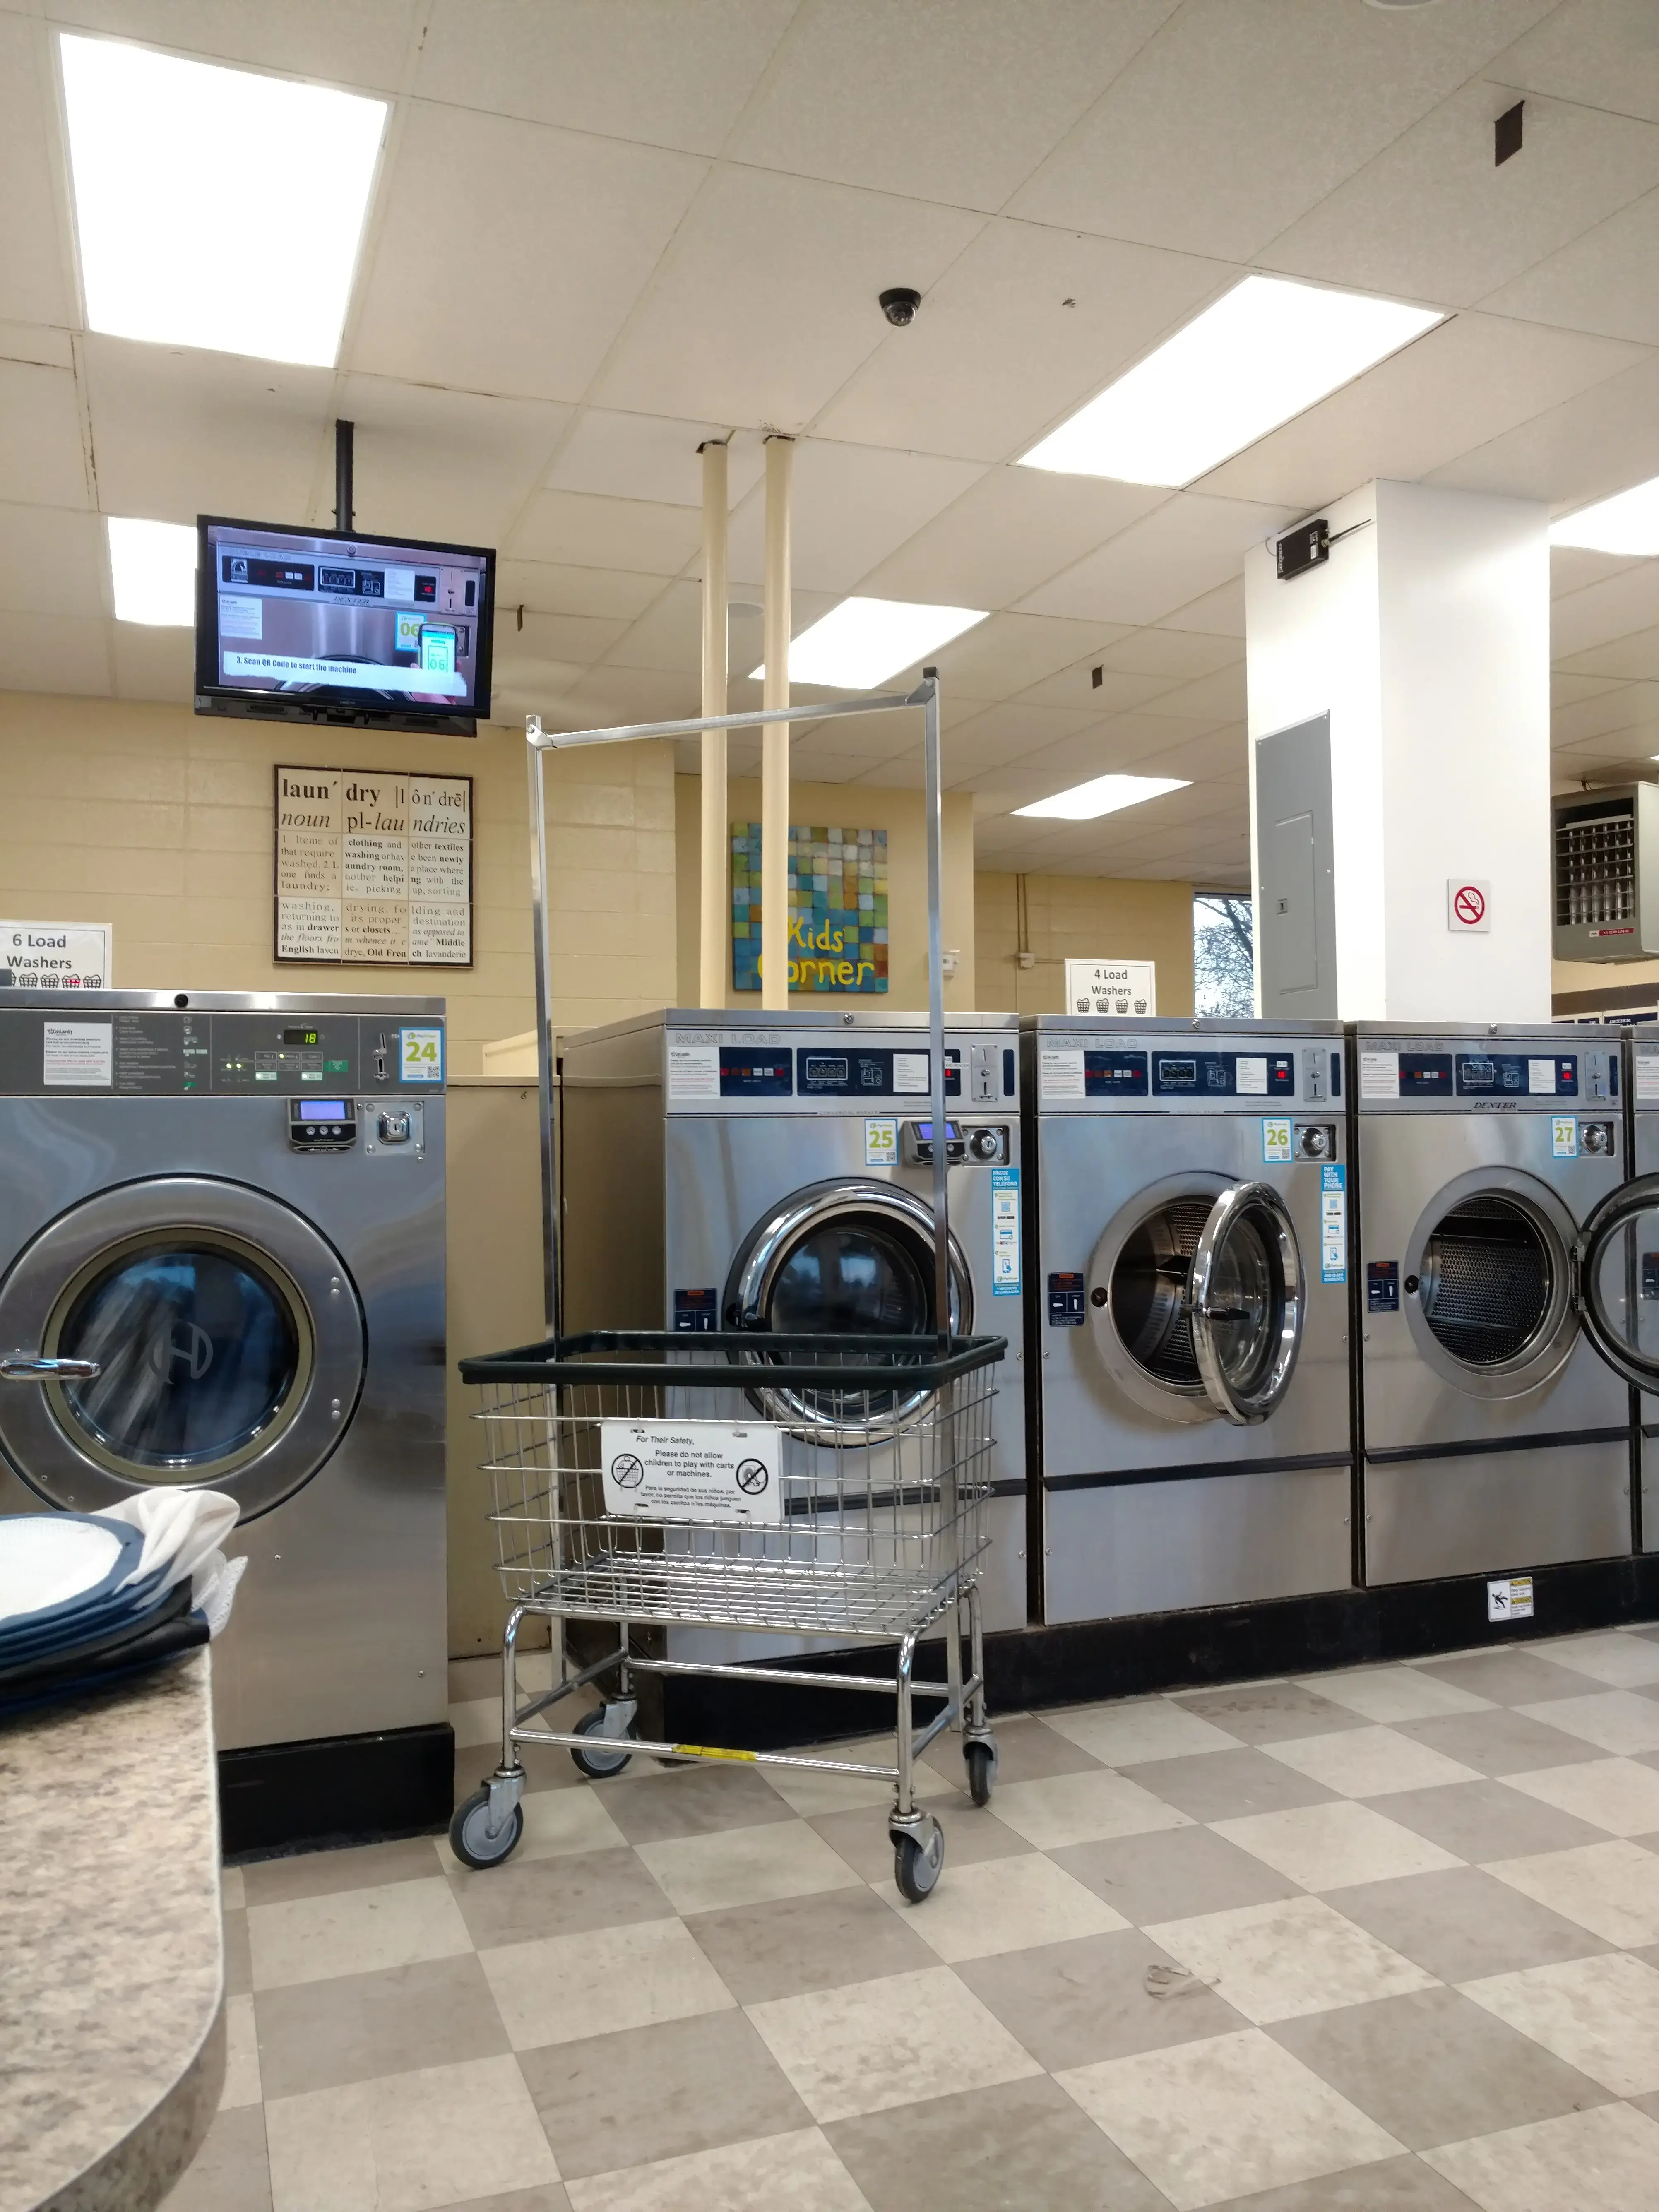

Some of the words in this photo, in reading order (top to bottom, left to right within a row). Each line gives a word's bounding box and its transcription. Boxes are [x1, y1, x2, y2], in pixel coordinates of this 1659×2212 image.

[244, 657, 260, 666] Scan
[262, 659, 271, 667] QR
[272, 660, 289, 668] Code
[328, 665, 357, 674] machine
[281, 813, 331, 828] noun
[283, 835, 289, 843] 1.
[296, 835, 323, 845] Items
[329, 837, 338, 846] of
[349, 839, 382, 849] clothing
[411, 841, 432, 850] other
[300, 848, 335, 858] require
[345, 851, 380, 861] washing
[418, 854, 436, 862] been
[440, 856, 463, 865] newly
[305, 870, 325, 880] finds
[417, 865, 438, 874] place
[281, 880, 329, 892] laundry;
[367, 884, 402, 895] picking
[447, 908, 464, 916] and
[281, 912, 326, 922] returning
[330, 914, 339, 922] to
[351, 913, 363, 923] its
[368, 916, 401, 925] proper
[413, 916, 465, 926] destination
[281, 933, 294, 941] the
[297, 933, 322, 942] floors
[356, 935, 387, 945] whence
[423, 928, 455, 937] opposed
[788, 916, 843, 952] Kids
[13, 934, 22, 947] 6
[28, 935, 66, 948] Load
[281, 945, 314, 955] English
[368, 948, 383, 957] Old
[426, 950, 466, 958] lavanderie
[7, 955, 72, 969] Washers
[758, 954, 874, 986] orner
[1094, 969, 1100, 979] 4
[1104, 969, 1127, 979] Load
[1091, 986, 1131, 995] Washers
[305, 1033, 316, 1043] 18
[676, 1033, 723, 1043] MAXI
[731, 1034, 781, 1044] LOAD
[1047, 1038, 1088, 1048] MAXI
[1095, 1039, 1137, 1048] LOAD
[406, 1041, 437, 1062] 24
[1366, 1041, 1402, 1051] MAXI
[1407, 1042, 1444, 1051] LOAD
[869, 1130, 893, 1148] 25
[1267, 1129, 1288, 1145] 26
[1555, 1126, 1573, 1142] 27
[670, 1437, 695, 1445] Safety,
[683, 1461, 698, 1469] play
[676, 1469, 712, 1478] machines.
